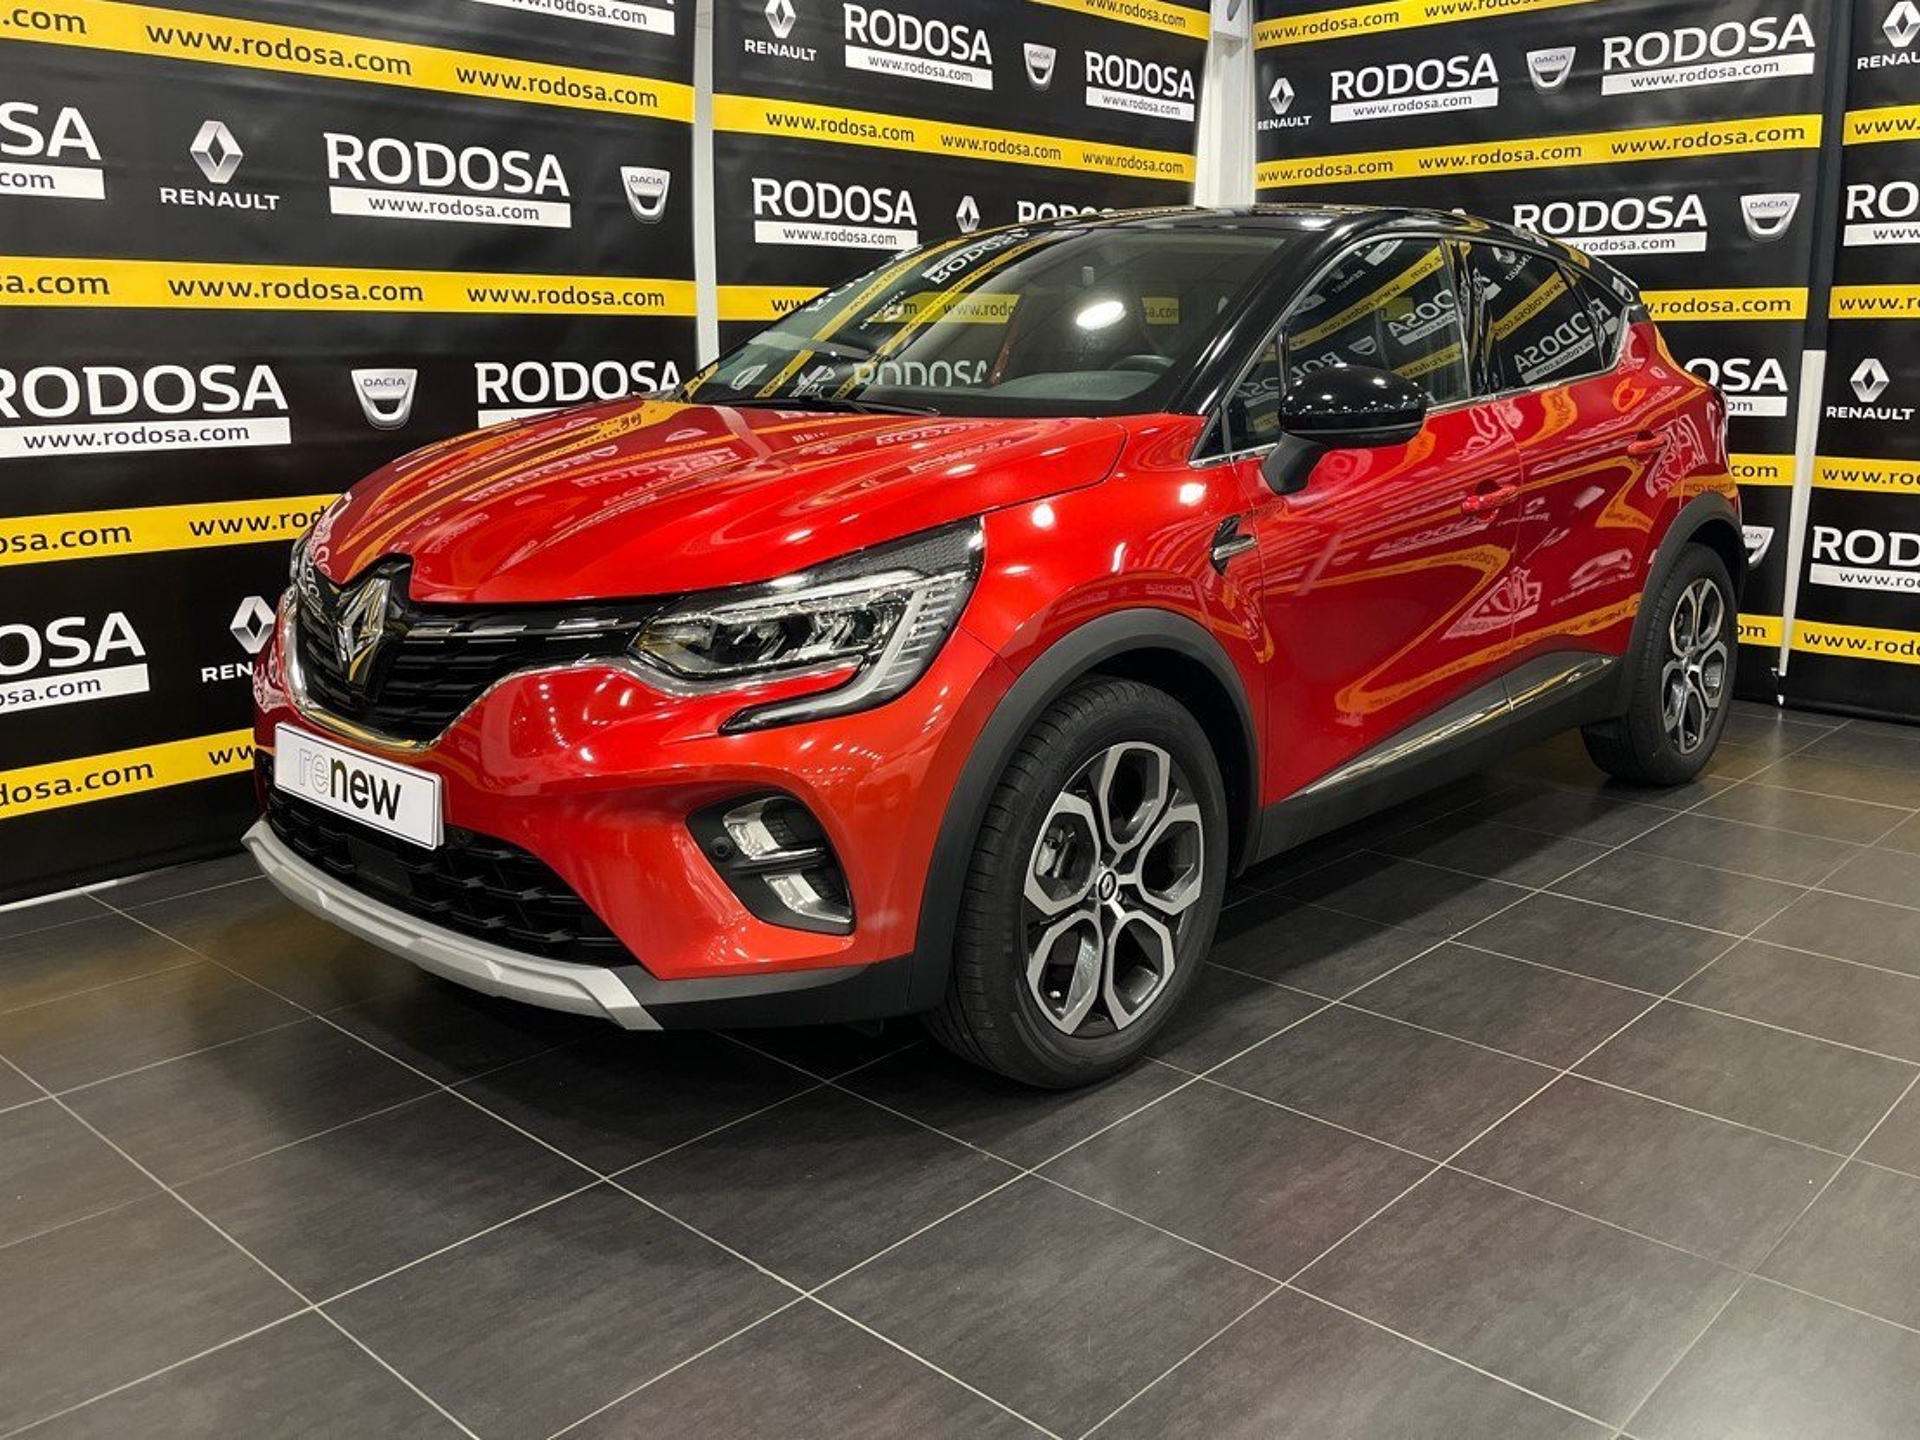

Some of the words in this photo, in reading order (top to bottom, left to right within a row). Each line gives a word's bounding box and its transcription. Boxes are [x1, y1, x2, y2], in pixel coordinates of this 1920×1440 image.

[843, 3, 992, 65] RODOSA
[1258, 10, 1399, 42] www.rodosa.com
[146, 24, 412, 76] www.rodosa.com
[744, 39, 817, 62] RENAULT
[1602, 13, 1816, 71] RODOSA
[868, 54, 973, 82] www.rodosa.com
[1534, 54, 1568, 64] DACIA
[456, 67, 658, 108] www.rodosa.com
[1084, 50, 1195, 100] RODOSA
[1330, 53, 1499, 101] RODOSA
[1631, 61, 1779, 88] www.rodosa.com
[1101, 94, 1181, 116] www.rodosa.com
[1353, 94, 1473, 116] www.rodosa.com
[766, 112, 915, 143] www.rodosa.com
[1611, 126, 1805, 154] www.rodosa.com
[940, 132, 1062, 161] www.rodosa.com
[1419, 145, 1582, 169] www.rodosa.com
[323, 132, 570, 197] RODOSA
[1082, 150, 1184, 175] www.rodosa.com
[1258, 158, 1394, 183] www.rodosa.com
[630, 175, 664, 186] DACIA
[160, 187, 280, 211] RENAULT
[368, 196, 540, 221] www.rodosa.com
[752, 177, 918, 225] RODOSA
[1750, 199, 1789, 209] DACIA
[1513, 194, 1708, 235] RODOSA
[783, 226, 897, 247] www.rodosa.com
[168, 277, 423, 303] www.rodosa.com
[467, 285, 665, 308] www.rodosa.com
[363, 377, 407, 388] DACIA
[474, 361, 681, 404] RODOSA
[1826, 406, 1915, 420] RENAULT
[23, 424, 250, 450] www.rodosa.com
[299, 748, 402, 821] renew
